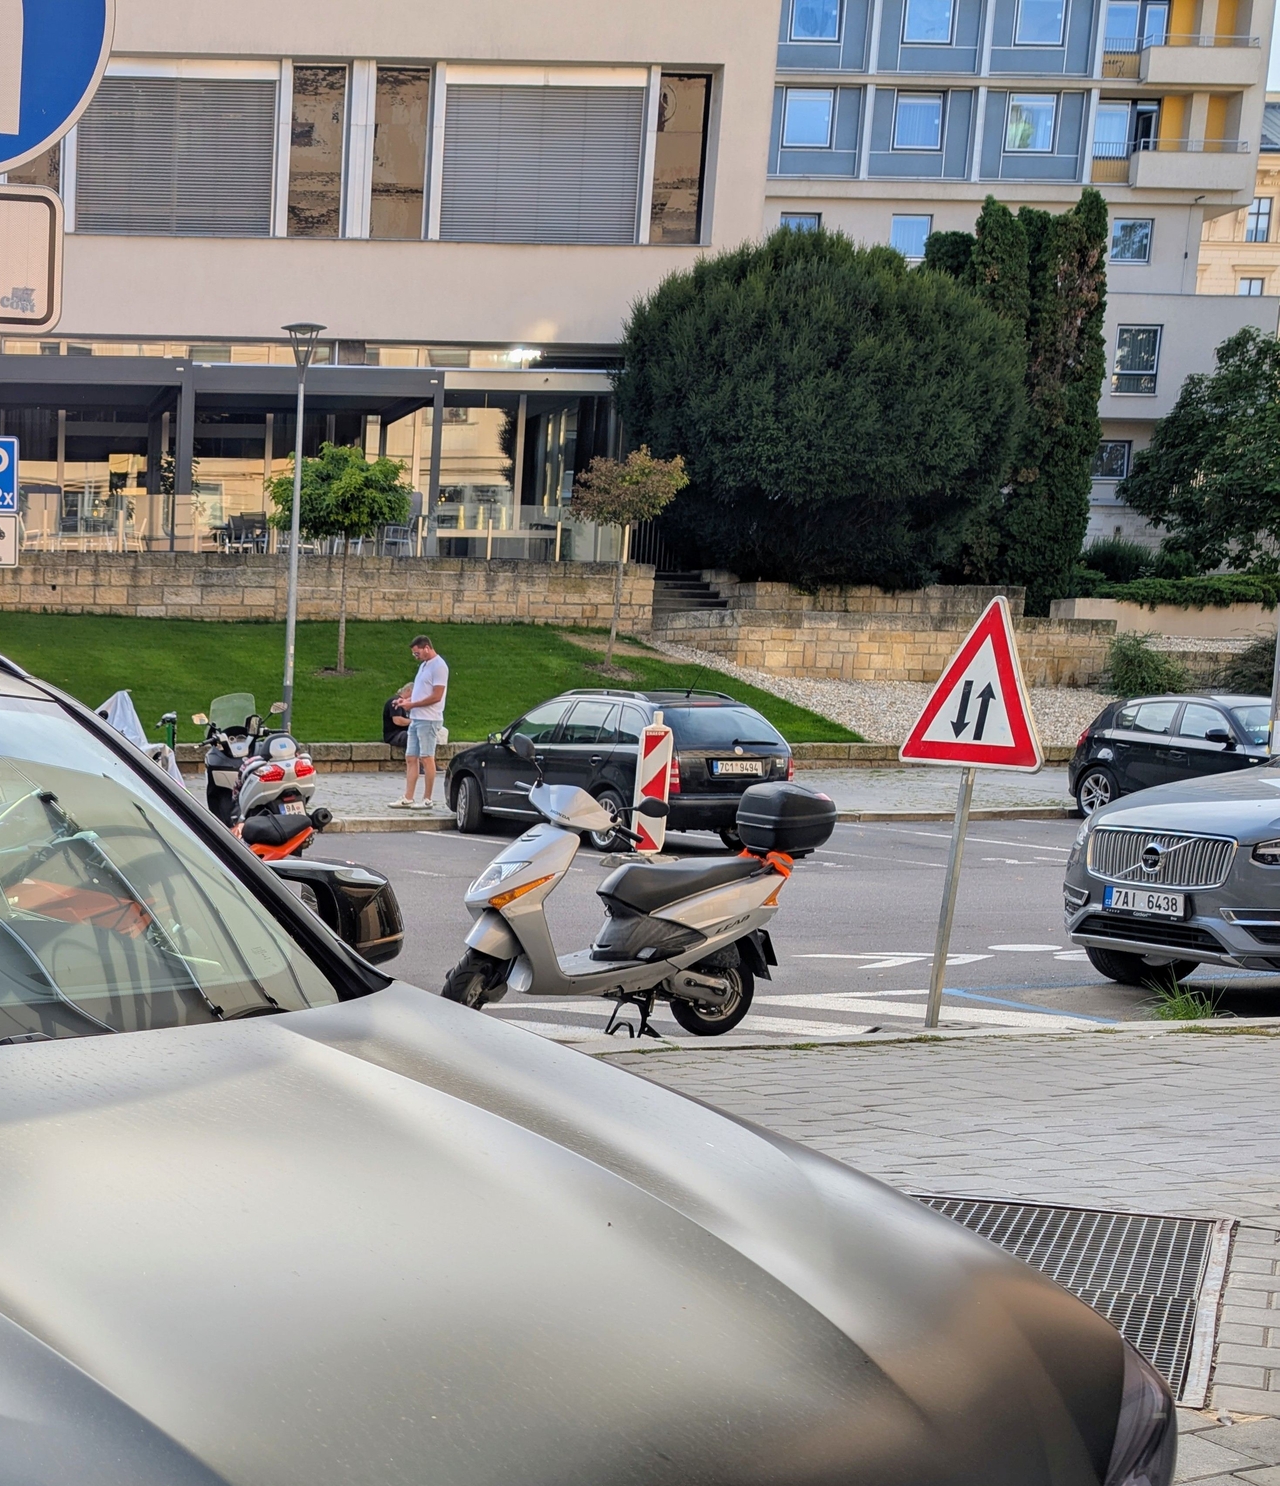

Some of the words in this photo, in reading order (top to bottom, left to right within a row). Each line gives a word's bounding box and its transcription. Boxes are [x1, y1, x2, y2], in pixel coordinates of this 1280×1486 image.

[720, 763, 734, 772] 7C1
[740, 763, 759, 772] 9494
[550, 809, 571, 821] HONDA
[1147, 894, 1178, 913] 6438
[715, 914, 751, 935] LEAD
